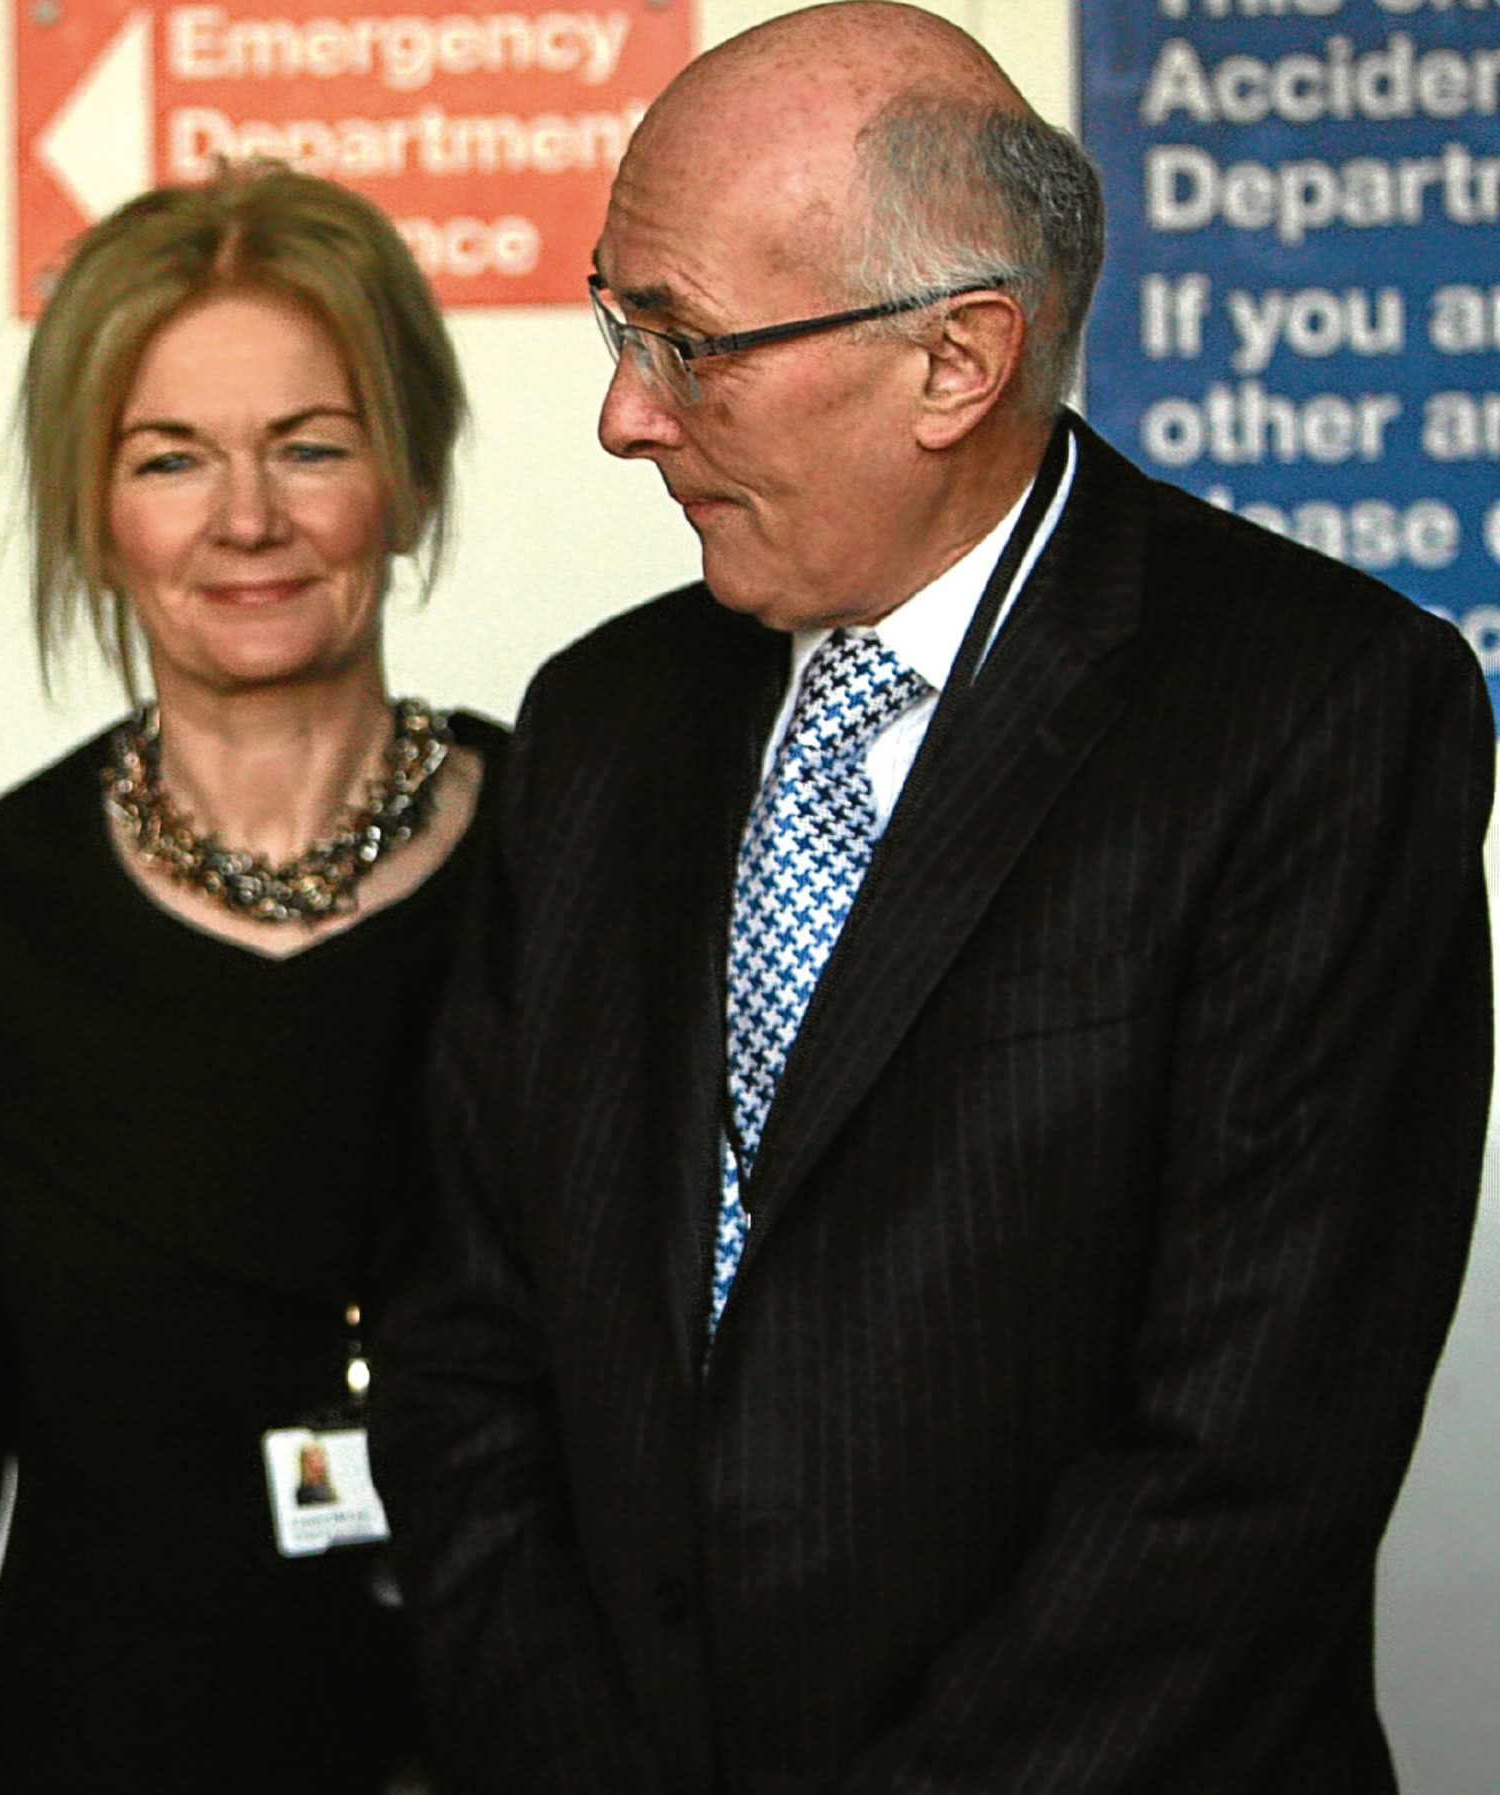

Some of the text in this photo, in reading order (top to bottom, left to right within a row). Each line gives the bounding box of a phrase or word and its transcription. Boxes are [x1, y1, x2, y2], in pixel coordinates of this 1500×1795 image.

[167, 6, 634, 90] Emergency
[1148, 142, 1500, 246] Depart
[1142, 272, 1211, 359] If
[1226, 286, 1404, 377] you
[1143, 379, 1401, 467] other
